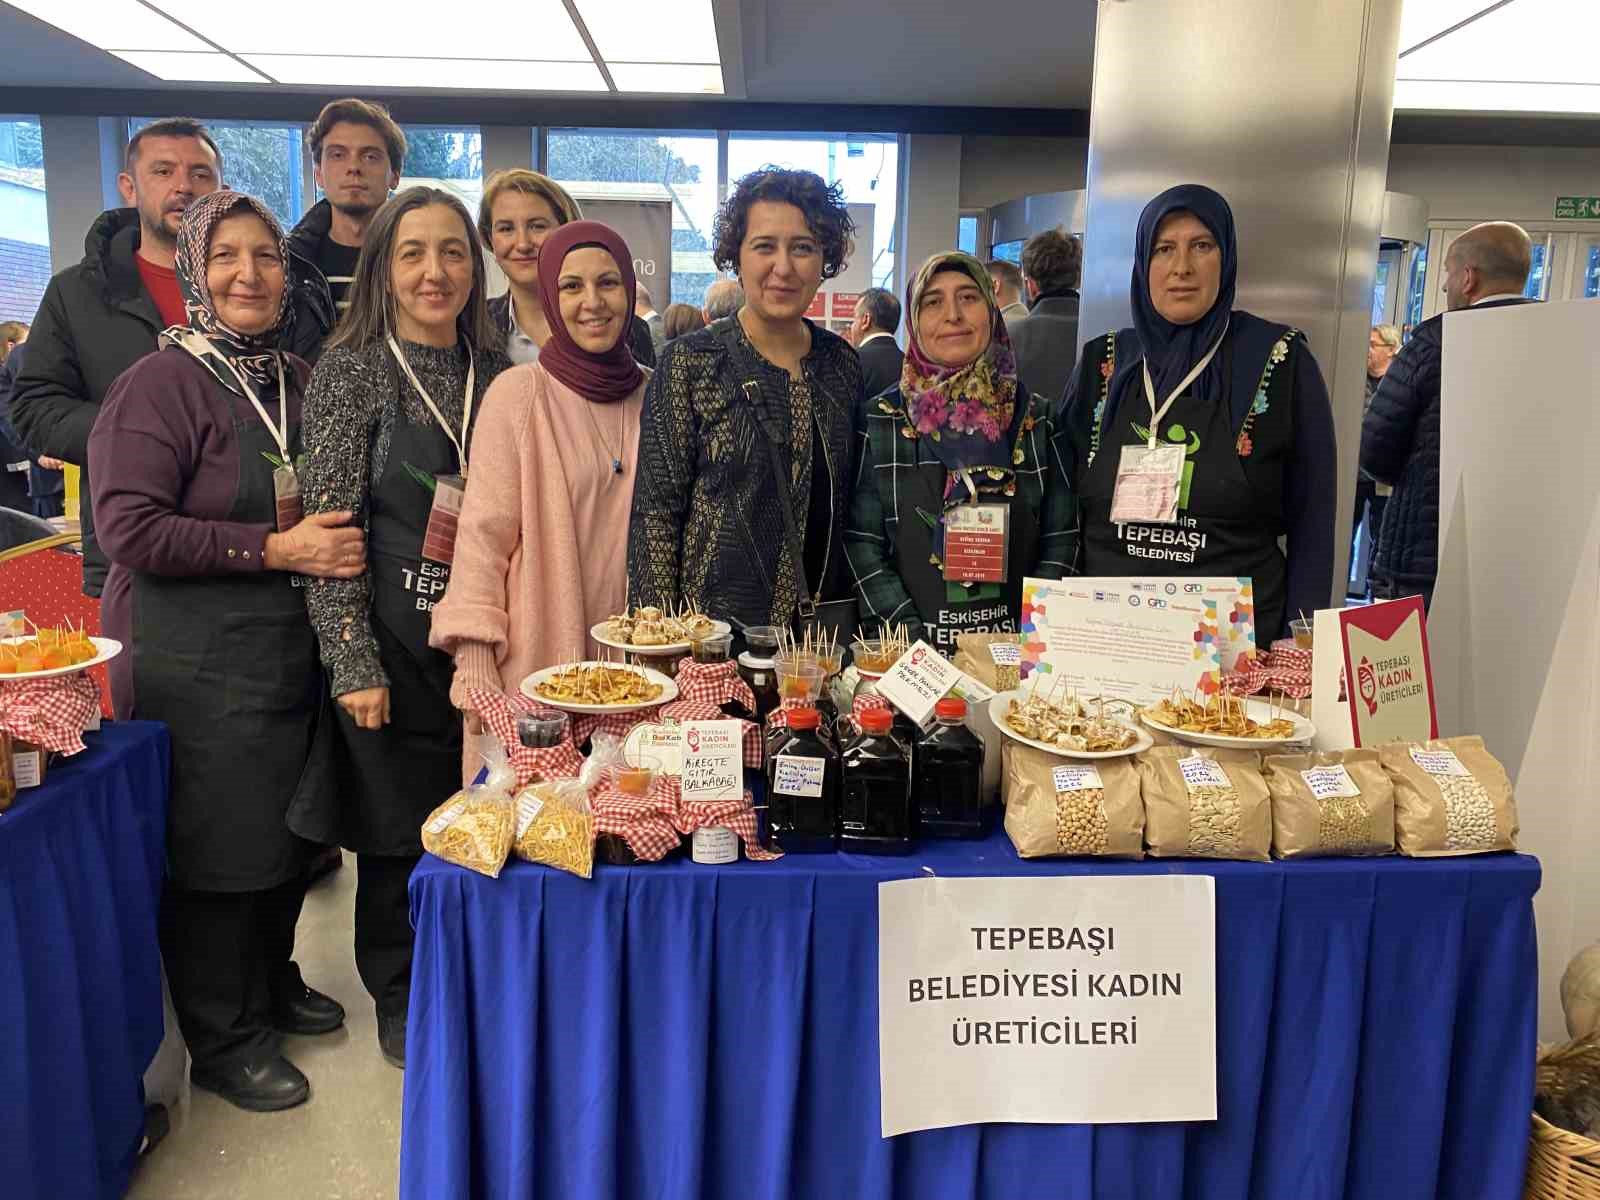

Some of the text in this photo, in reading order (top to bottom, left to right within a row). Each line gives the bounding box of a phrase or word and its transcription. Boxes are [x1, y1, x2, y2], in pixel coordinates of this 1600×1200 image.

[1114, 521, 1207, 552] TEPEBAŞI
[1127, 544, 1195, 563] BELEDİYESİ
[938, 604, 1009, 625] ESKİŞEHİR
[1376, 656, 1410, 672] TEPEBAŞI
[1378, 668, 1412, 688] KADIN
[1380, 682, 1424, 704] ÜRETİCİLERİ
[971, 926, 1115, 956] TEPEBAŞI
[908, 968, 1182, 1002] BELEDİYESİ KADIN
[952, 1015, 1137, 1046] ÜRETİCİLERİ
